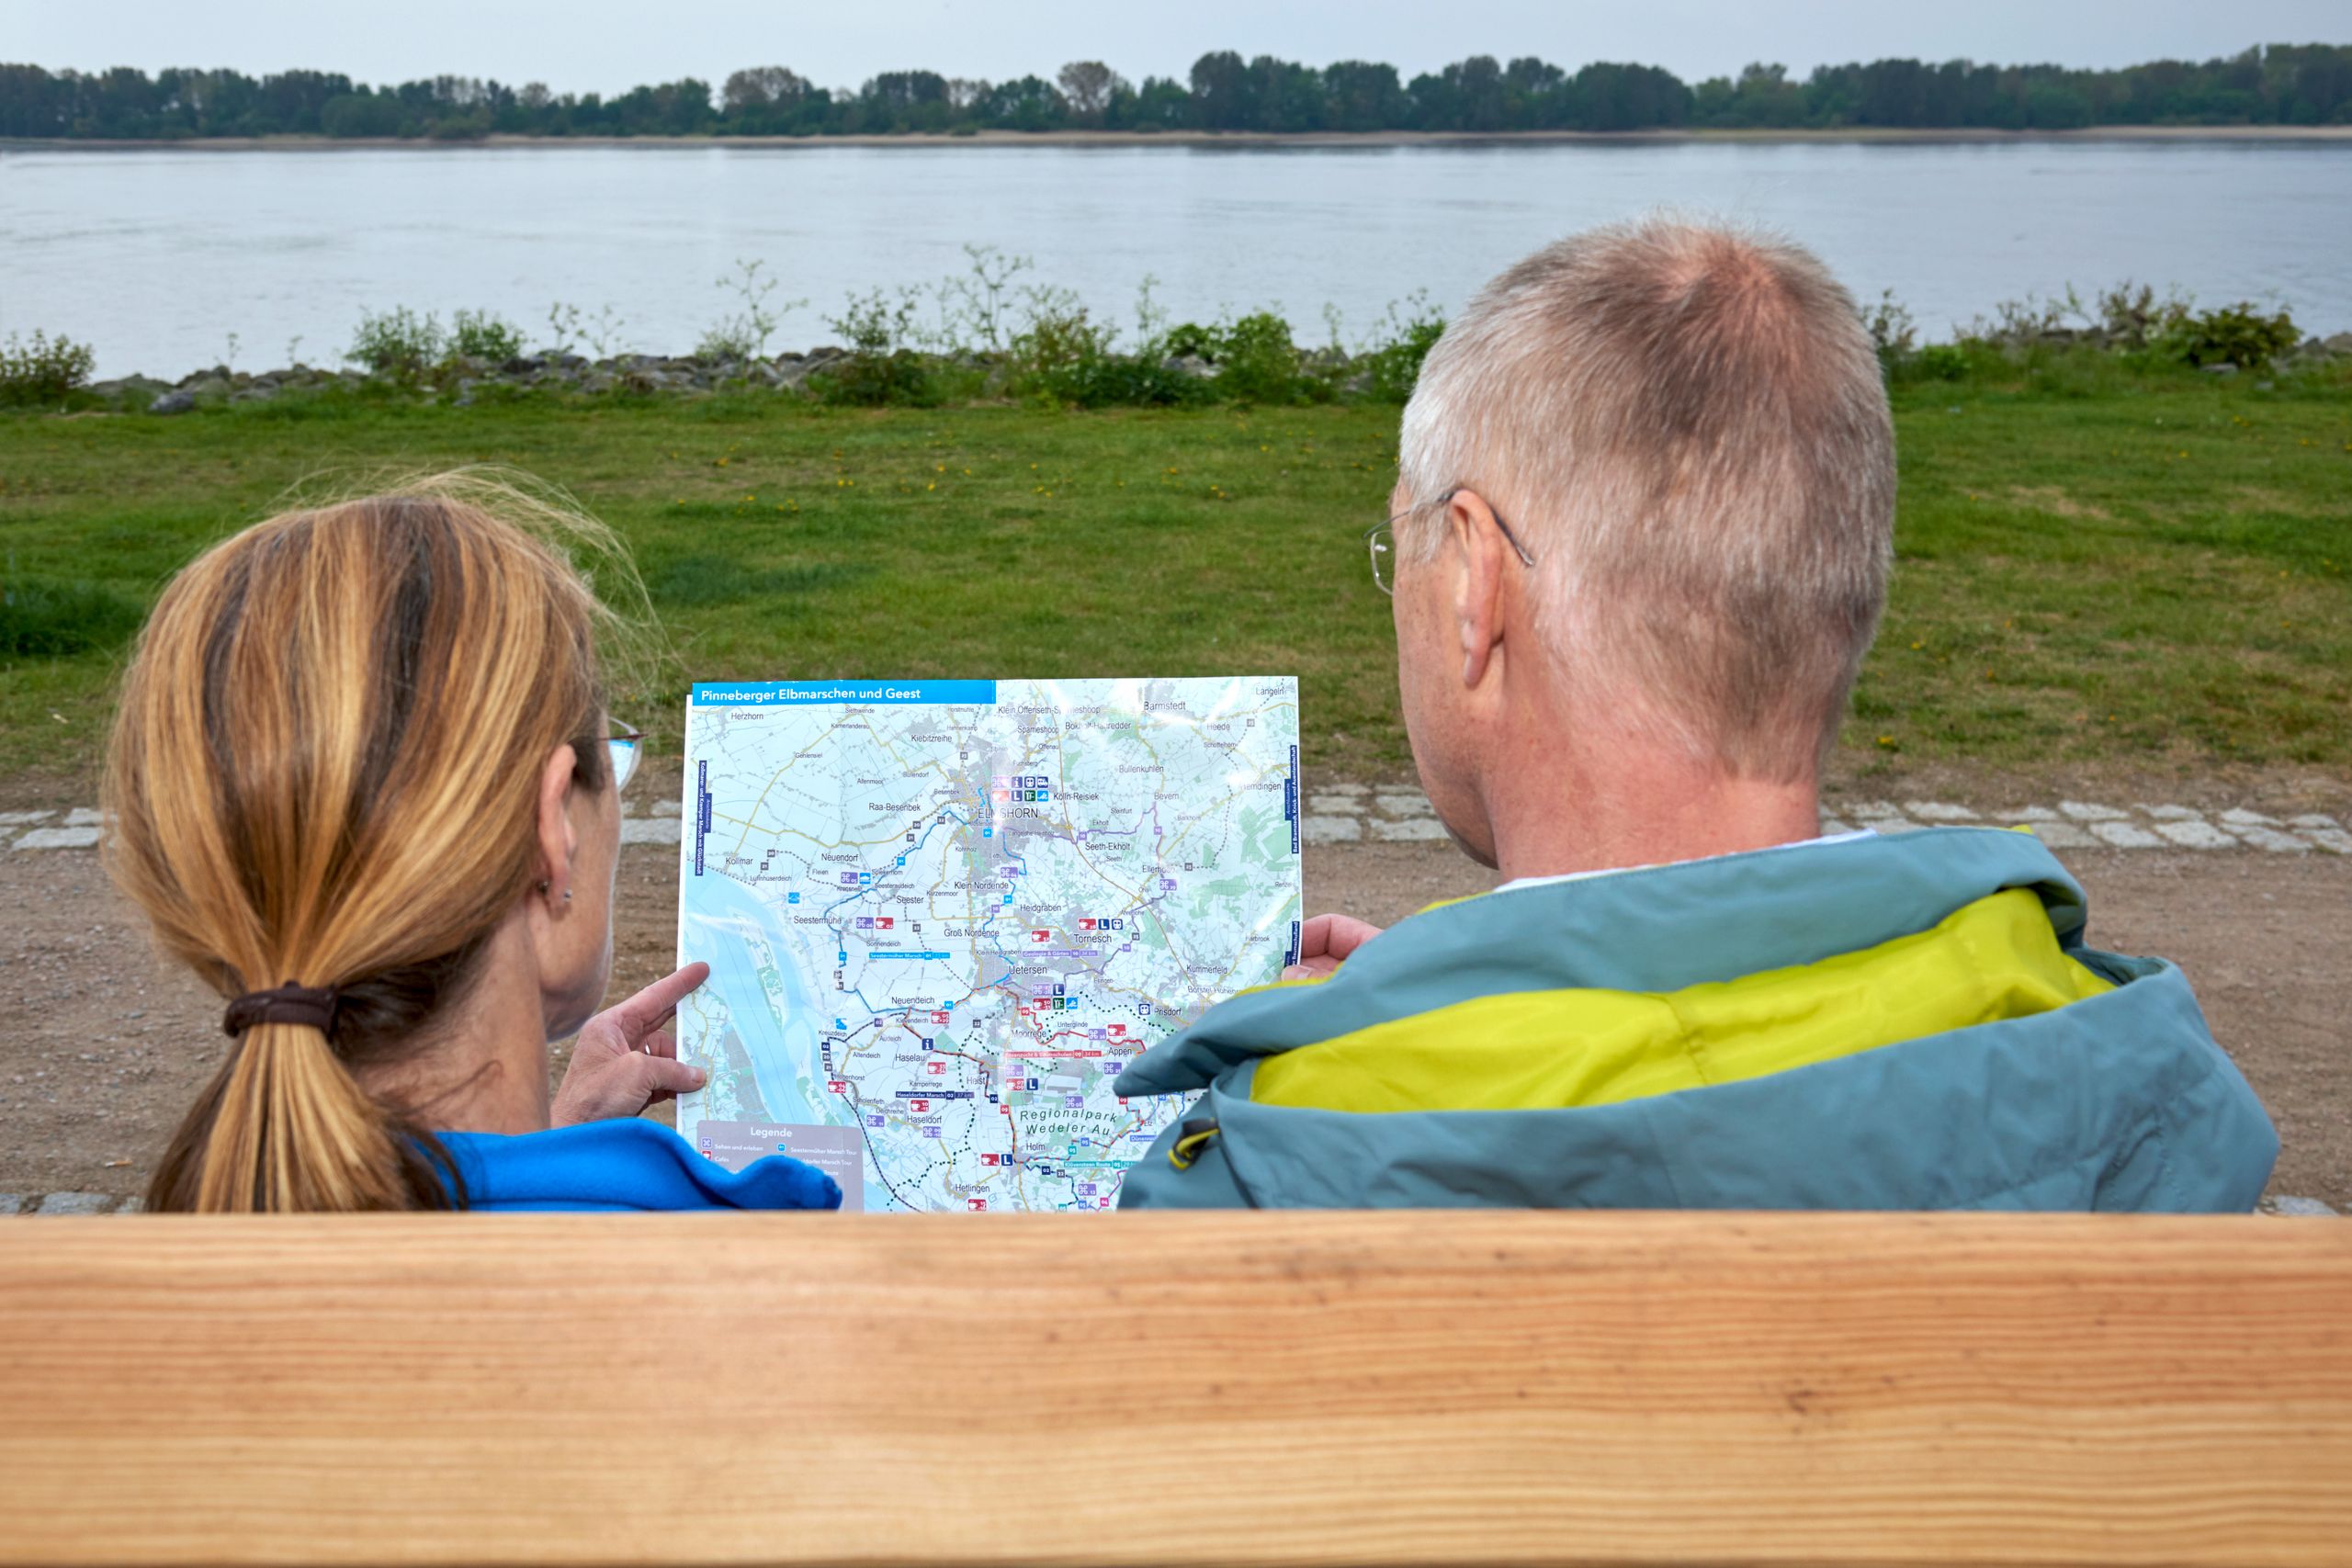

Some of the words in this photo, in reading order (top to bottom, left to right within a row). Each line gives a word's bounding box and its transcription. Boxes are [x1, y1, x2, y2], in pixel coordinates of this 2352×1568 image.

[701, 690, 775, 704] Pinneberger
[778, 687, 855, 700] Elbmarschen
[859, 688, 882, 699] und
[885, 687, 921, 699] Geest
[1256, 687, 1284, 697] Langeln
[998, 705, 1016, 715] Klein
[1144, 701, 1186, 711] Barmstedt
[730, 712, 764, 721] Herzhorn
[1065, 721, 1132, 731] Bokolt-Haredder
[1206, 722, 1231, 731] Heede
[910, 734, 953, 743] Kiebitzreihe
[1118, 765, 1164, 773] Bullenkuhlen
[1245, 783, 1282, 793] emdingen
[1154, 792, 1180, 801] Bevern
[869, 802, 921, 812] Raa-Besenbek
[1085, 841, 1131, 852] Seeth-Ekholt
[725, 857, 753, 865] Kollmar
[820, 853, 859, 863] Neuendorf
[954, 881, 972, 890] Klein
[974, 881, 1010, 890] Nordende
[896, 895, 924, 905] Seester
[1020, 903, 1062, 914] Heidgraben
[944, 929, 963, 937] Groß
[964, 929, 1000, 938] Nordende
[1074, 933, 1112, 944] Tornesch
[1008, 965, 1047, 976] Uetersen
[1186, 964, 1227, 975] Kummerfeld
[891, 996, 935, 1006] Neuendeich
[1154, 1007, 1182, 1016] Prisdorf
[1057, 1021, 1089, 1029] Unterglinde
[1011, 1029, 1047, 1039] Moorrege
[1108, 1046, 1133, 1057] Appen
[895, 1054, 925, 1062] Haselau
[967, 1077, 986, 1085] Heist
[907, 1115, 943, 1124] Haseldorf
[1020, 1108, 1117, 1123] Regionalpark
[751, 1127, 793, 1138] Legende
[1025, 1122, 1086, 1135] Wedeler
[1091, 1125, 1111, 1136] Au
[1025, 1142, 1046, 1151] Holm
[956, 1184, 990, 1193] Hetlingen
